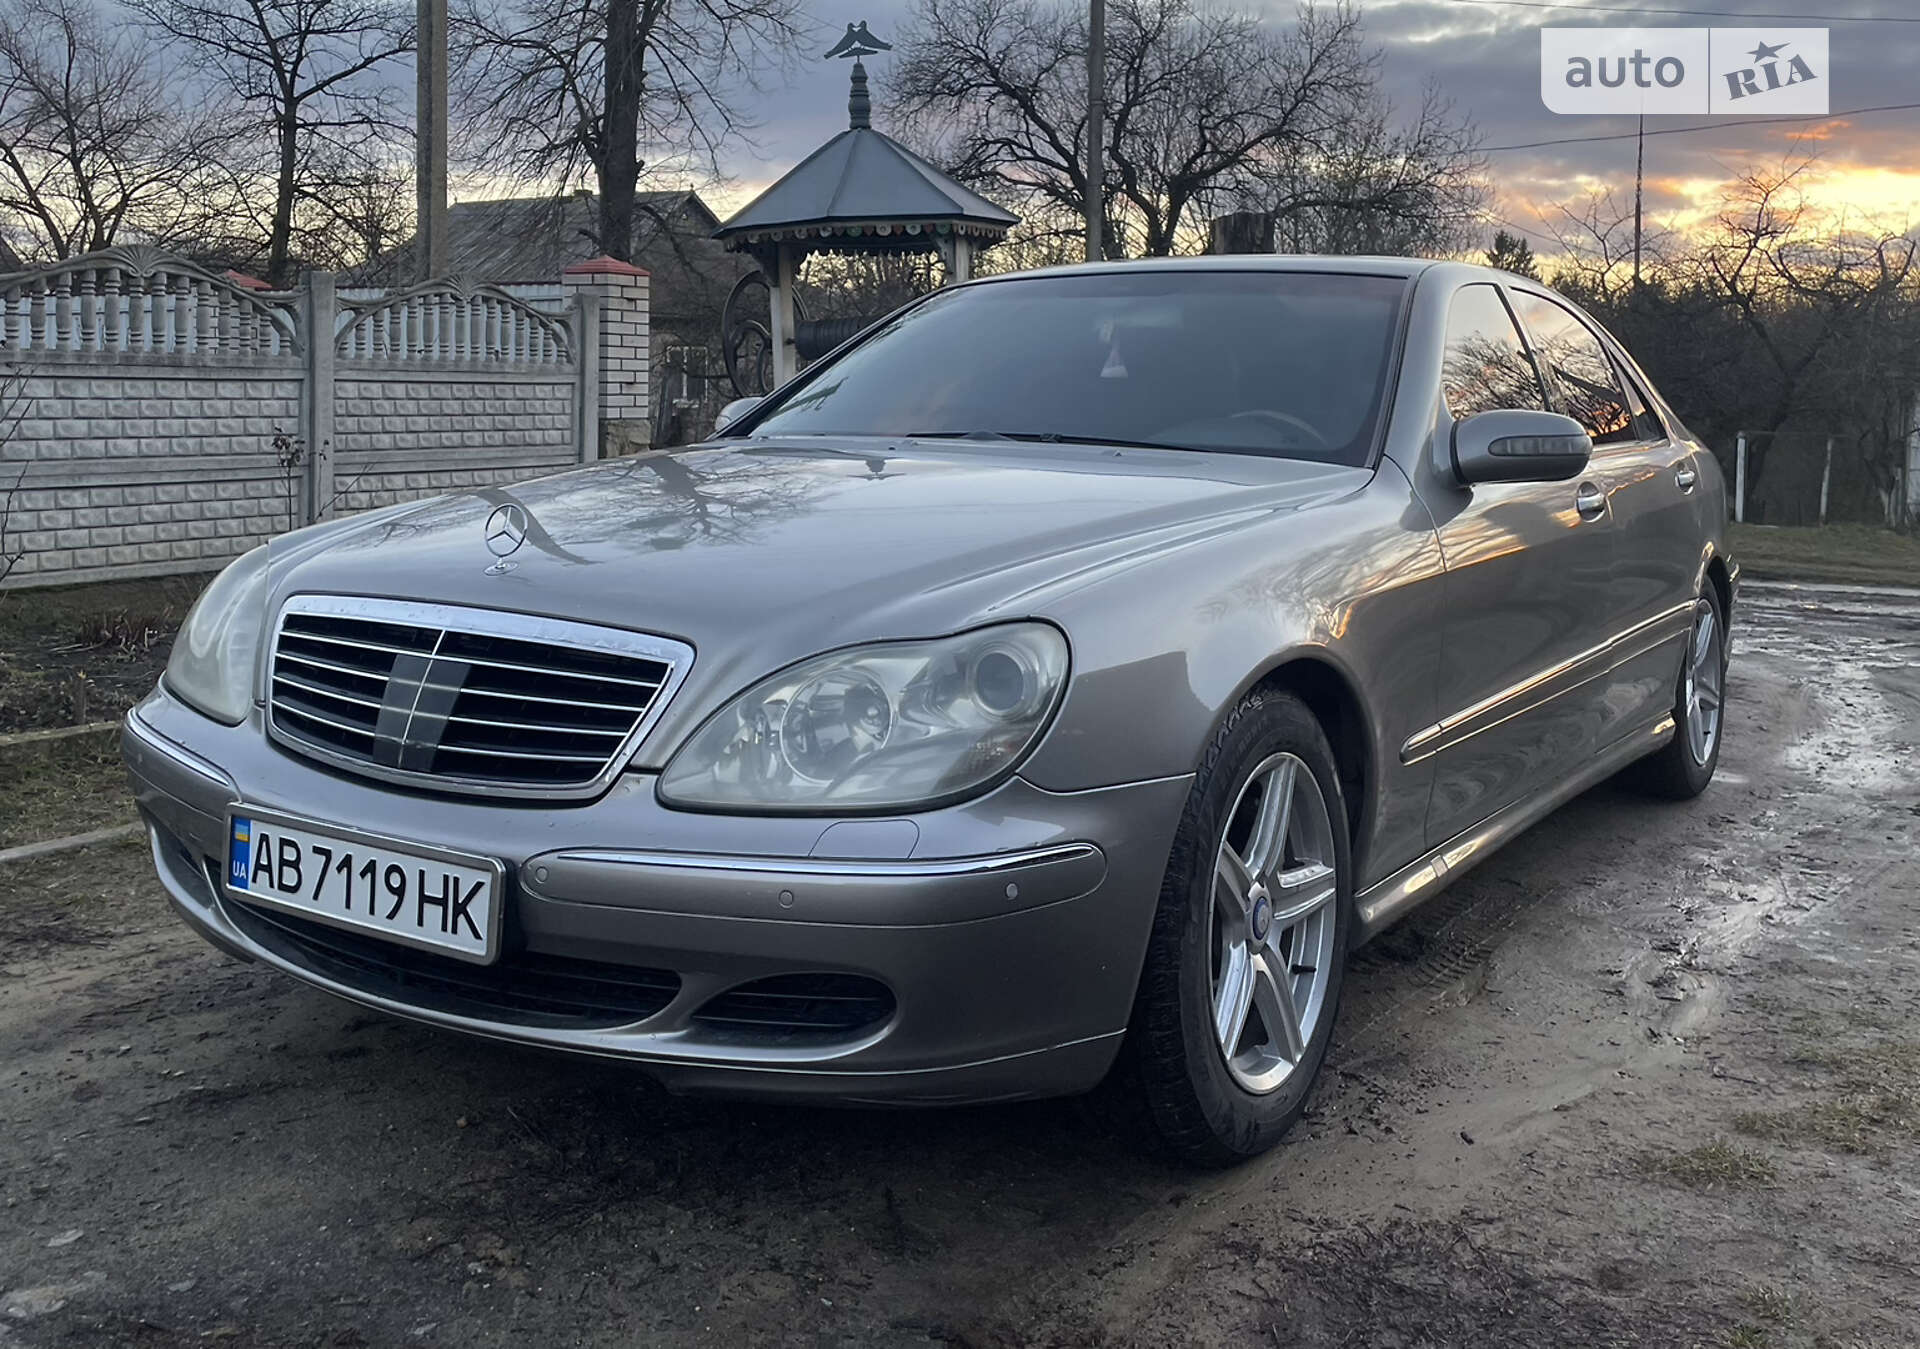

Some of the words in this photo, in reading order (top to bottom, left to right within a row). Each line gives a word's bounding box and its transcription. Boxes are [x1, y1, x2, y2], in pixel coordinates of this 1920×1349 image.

[232, 859, 247, 880] UA
[251, 833, 302, 893] AB
[312, 845, 406, 920] 7119
[417, 869, 485, 940] HK
